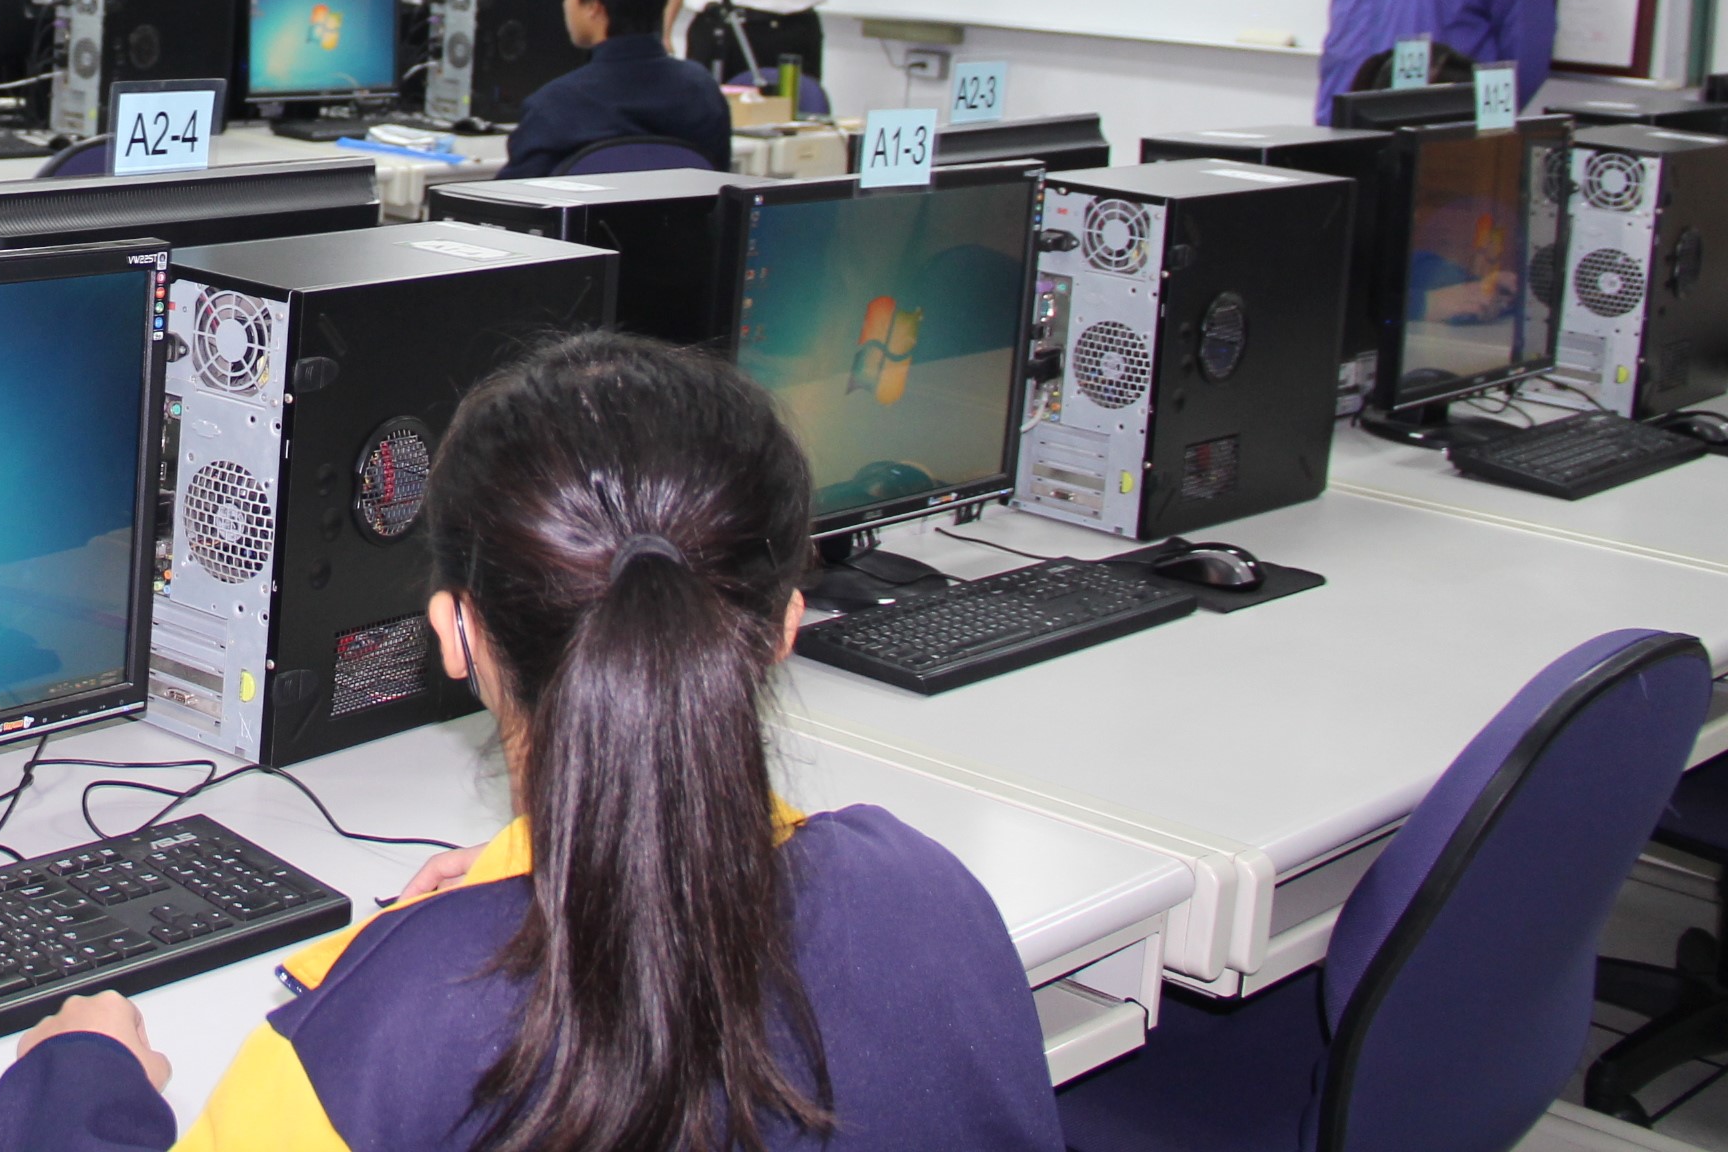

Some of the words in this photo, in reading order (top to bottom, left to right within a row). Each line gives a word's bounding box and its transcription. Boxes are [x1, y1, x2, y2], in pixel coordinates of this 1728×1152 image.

[954, 75, 996, 110] A2-3
[1482, 82, 1511, 114] A1-2
[124, 109, 199, 158] A2-4
[870, 124, 928, 168] A1-3
[150, 831, 198, 850] ASUS
